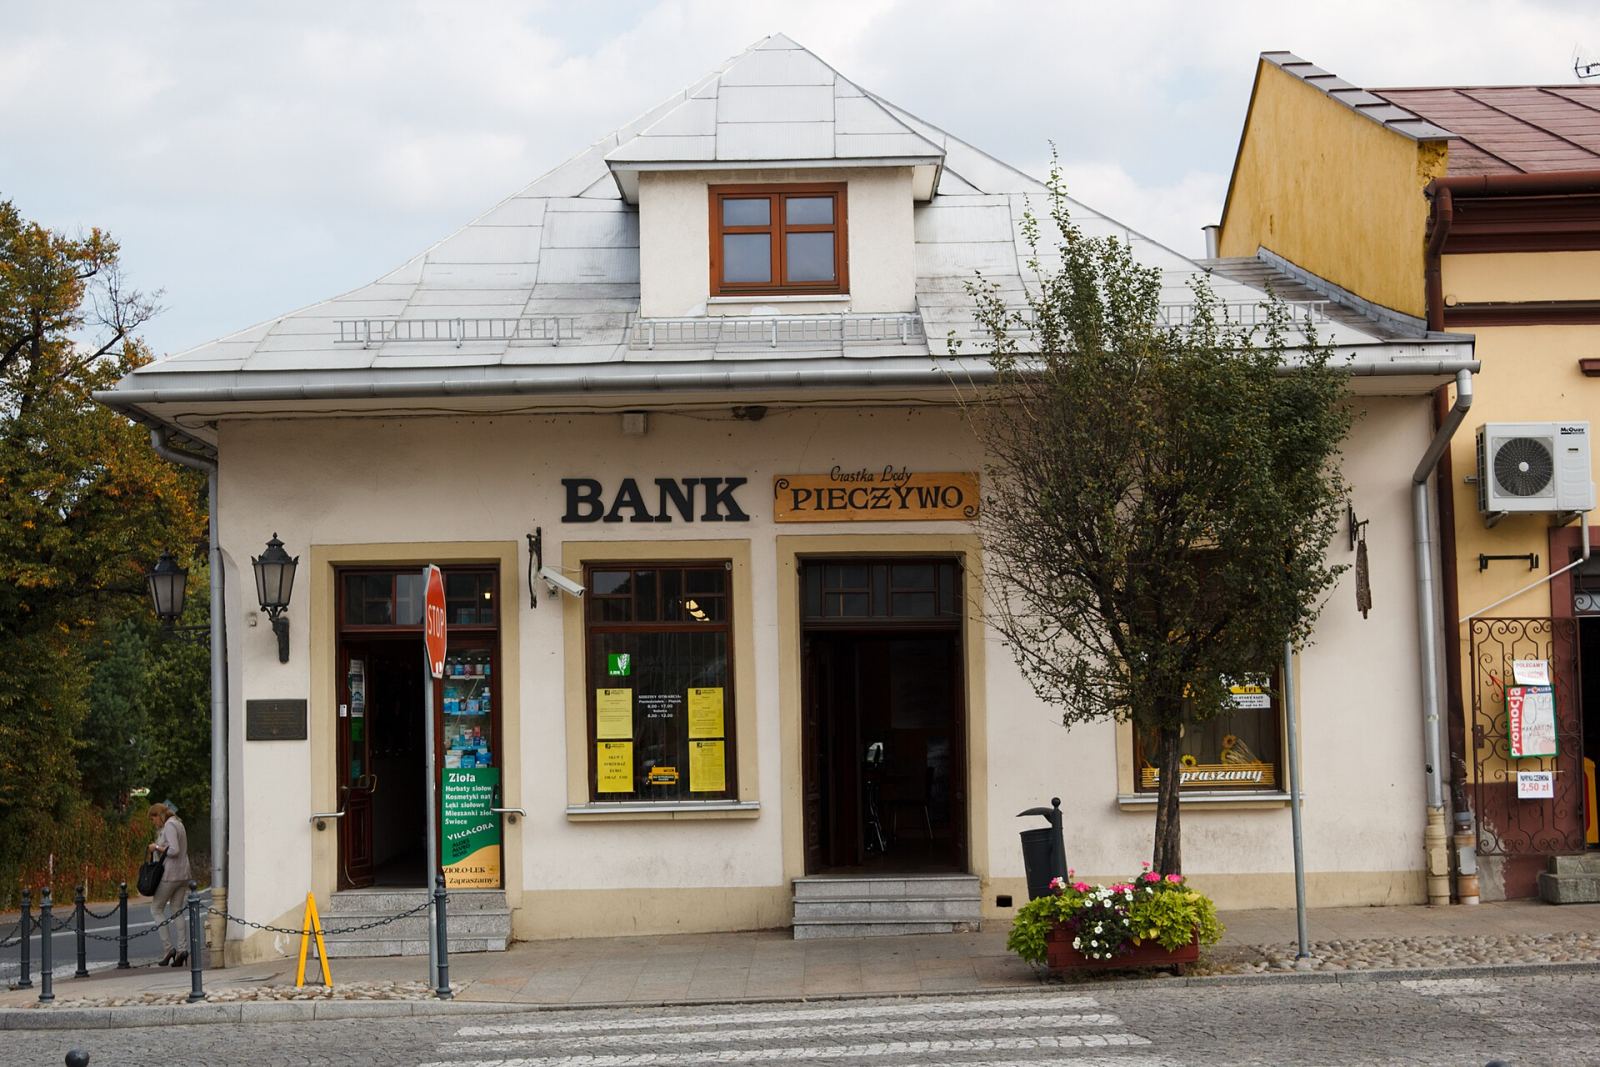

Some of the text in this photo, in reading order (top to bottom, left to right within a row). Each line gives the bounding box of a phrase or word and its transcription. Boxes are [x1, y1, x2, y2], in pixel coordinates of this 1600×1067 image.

[830, 464, 912, 487] Ciastka Lody
[561, 478, 750, 522] BANK
[790, 486, 964, 511] PIECZYWO
[428, 604, 444, 639] STOP
[1507, 687, 1523, 756] Promocja
[448, 772, 476, 783] Zioła
[1521, 783, 1540, 792] 2,50
[446, 793, 479, 801] Kosmetyki
[447, 822, 495, 841] VILCACORA
[449, 877, 493, 885] Zapraszamy
